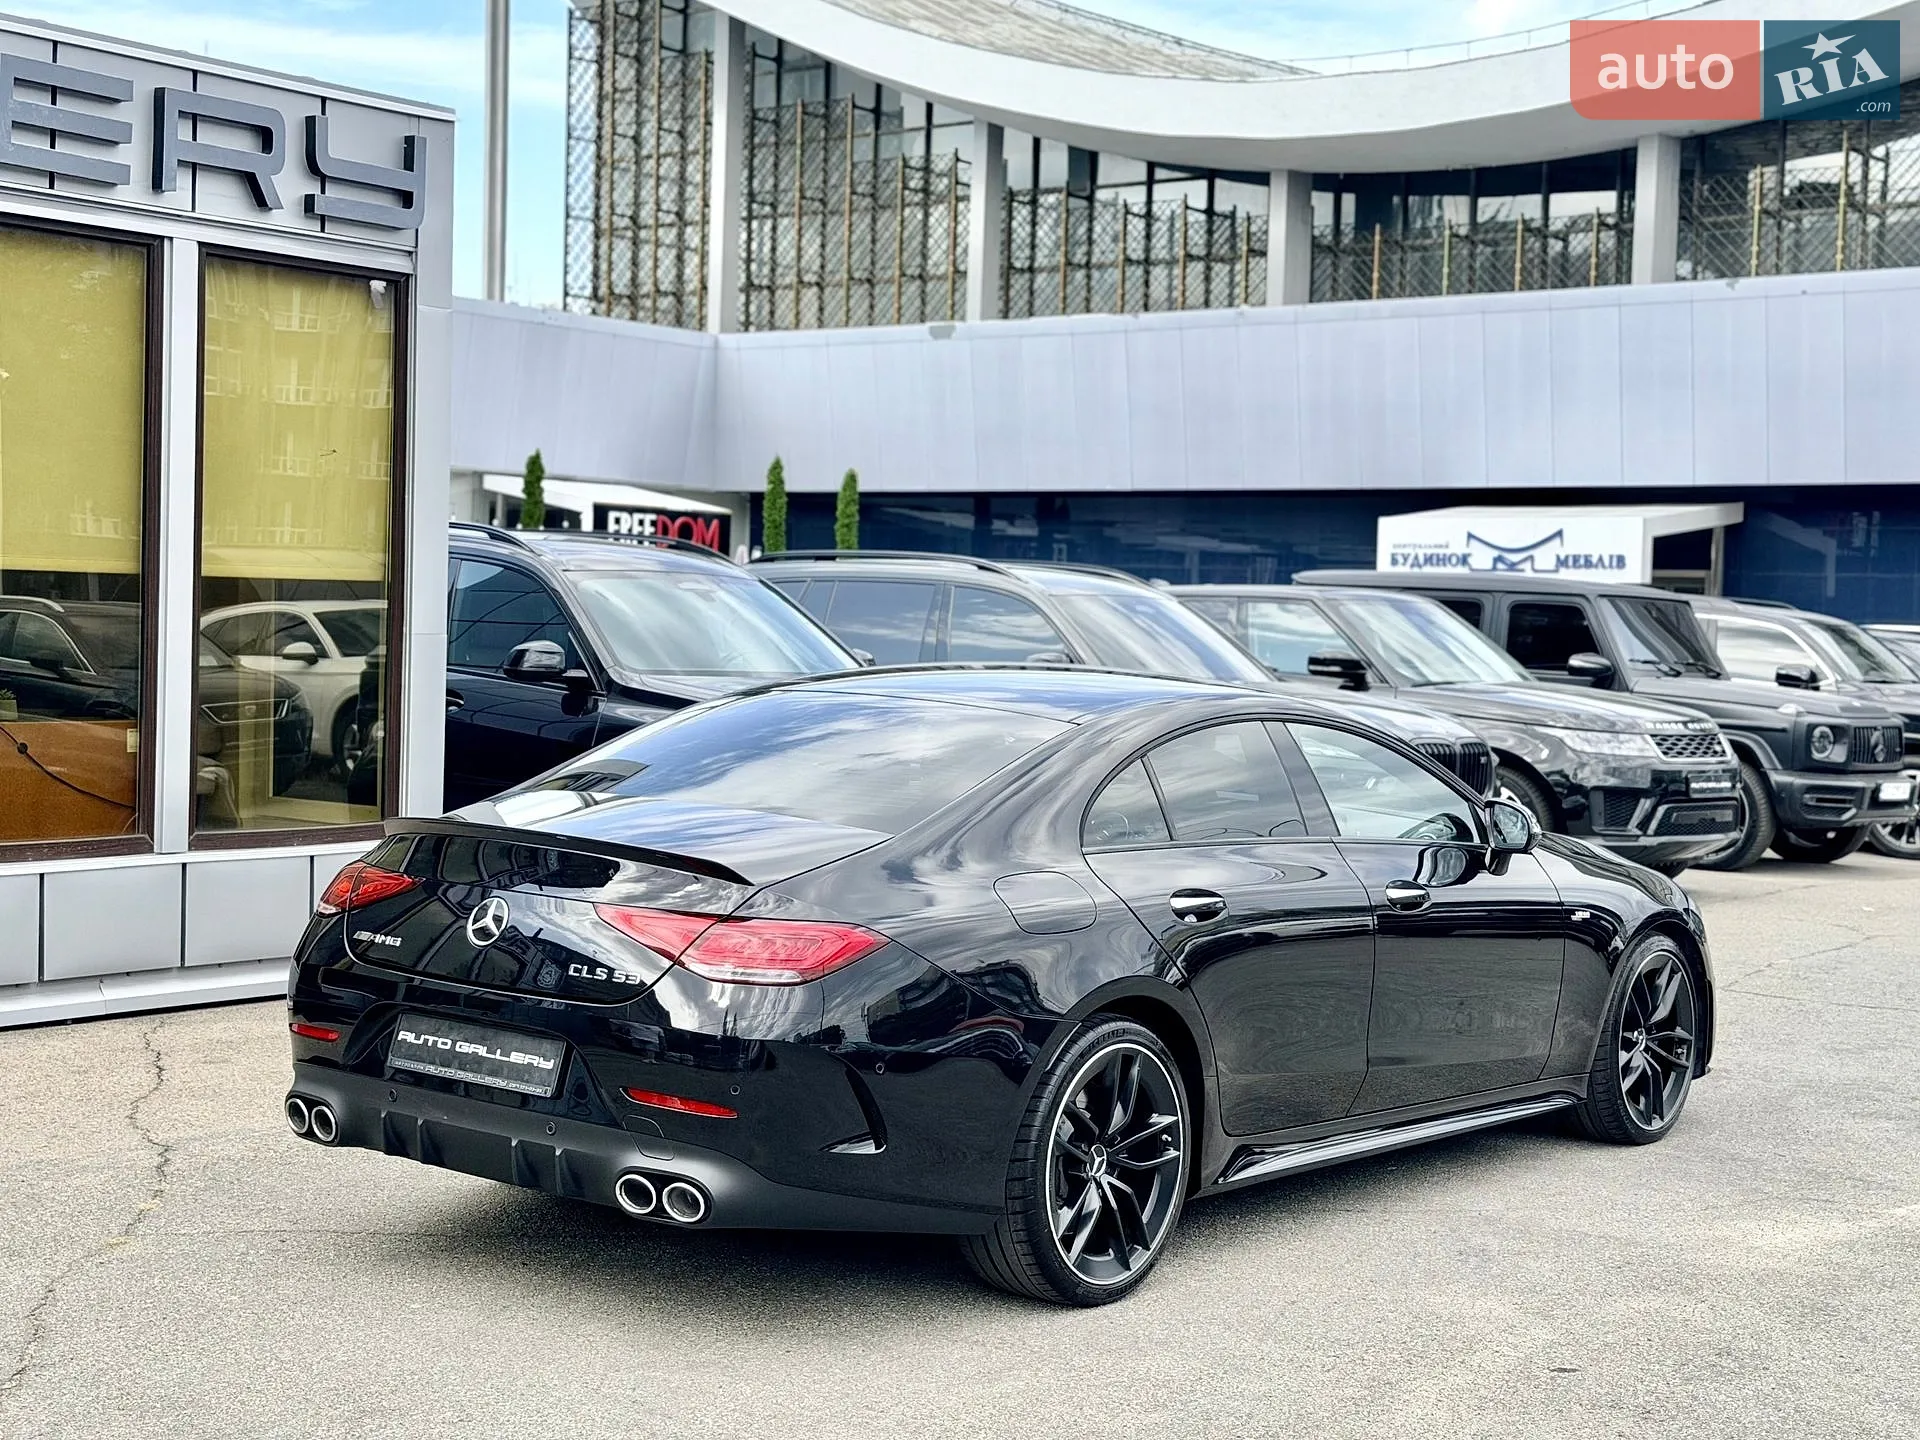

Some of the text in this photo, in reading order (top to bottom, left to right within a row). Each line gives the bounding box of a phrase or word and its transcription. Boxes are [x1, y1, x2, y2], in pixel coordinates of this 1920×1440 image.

[0, 53, 427, 229] ERY
[608, 510, 720, 552] FREEDOM
[1390, 552, 1626, 569] БУДИНОК МЕБЛІВ
[367, 932, 402, 947] AMG
[568, 963, 641, 985] CLS 53
[397, 1030, 555, 1070] AUTO GALLERY
[425, 1065, 455, 1077] AUTO
[456, 1071, 507, 1087] GALLERY
